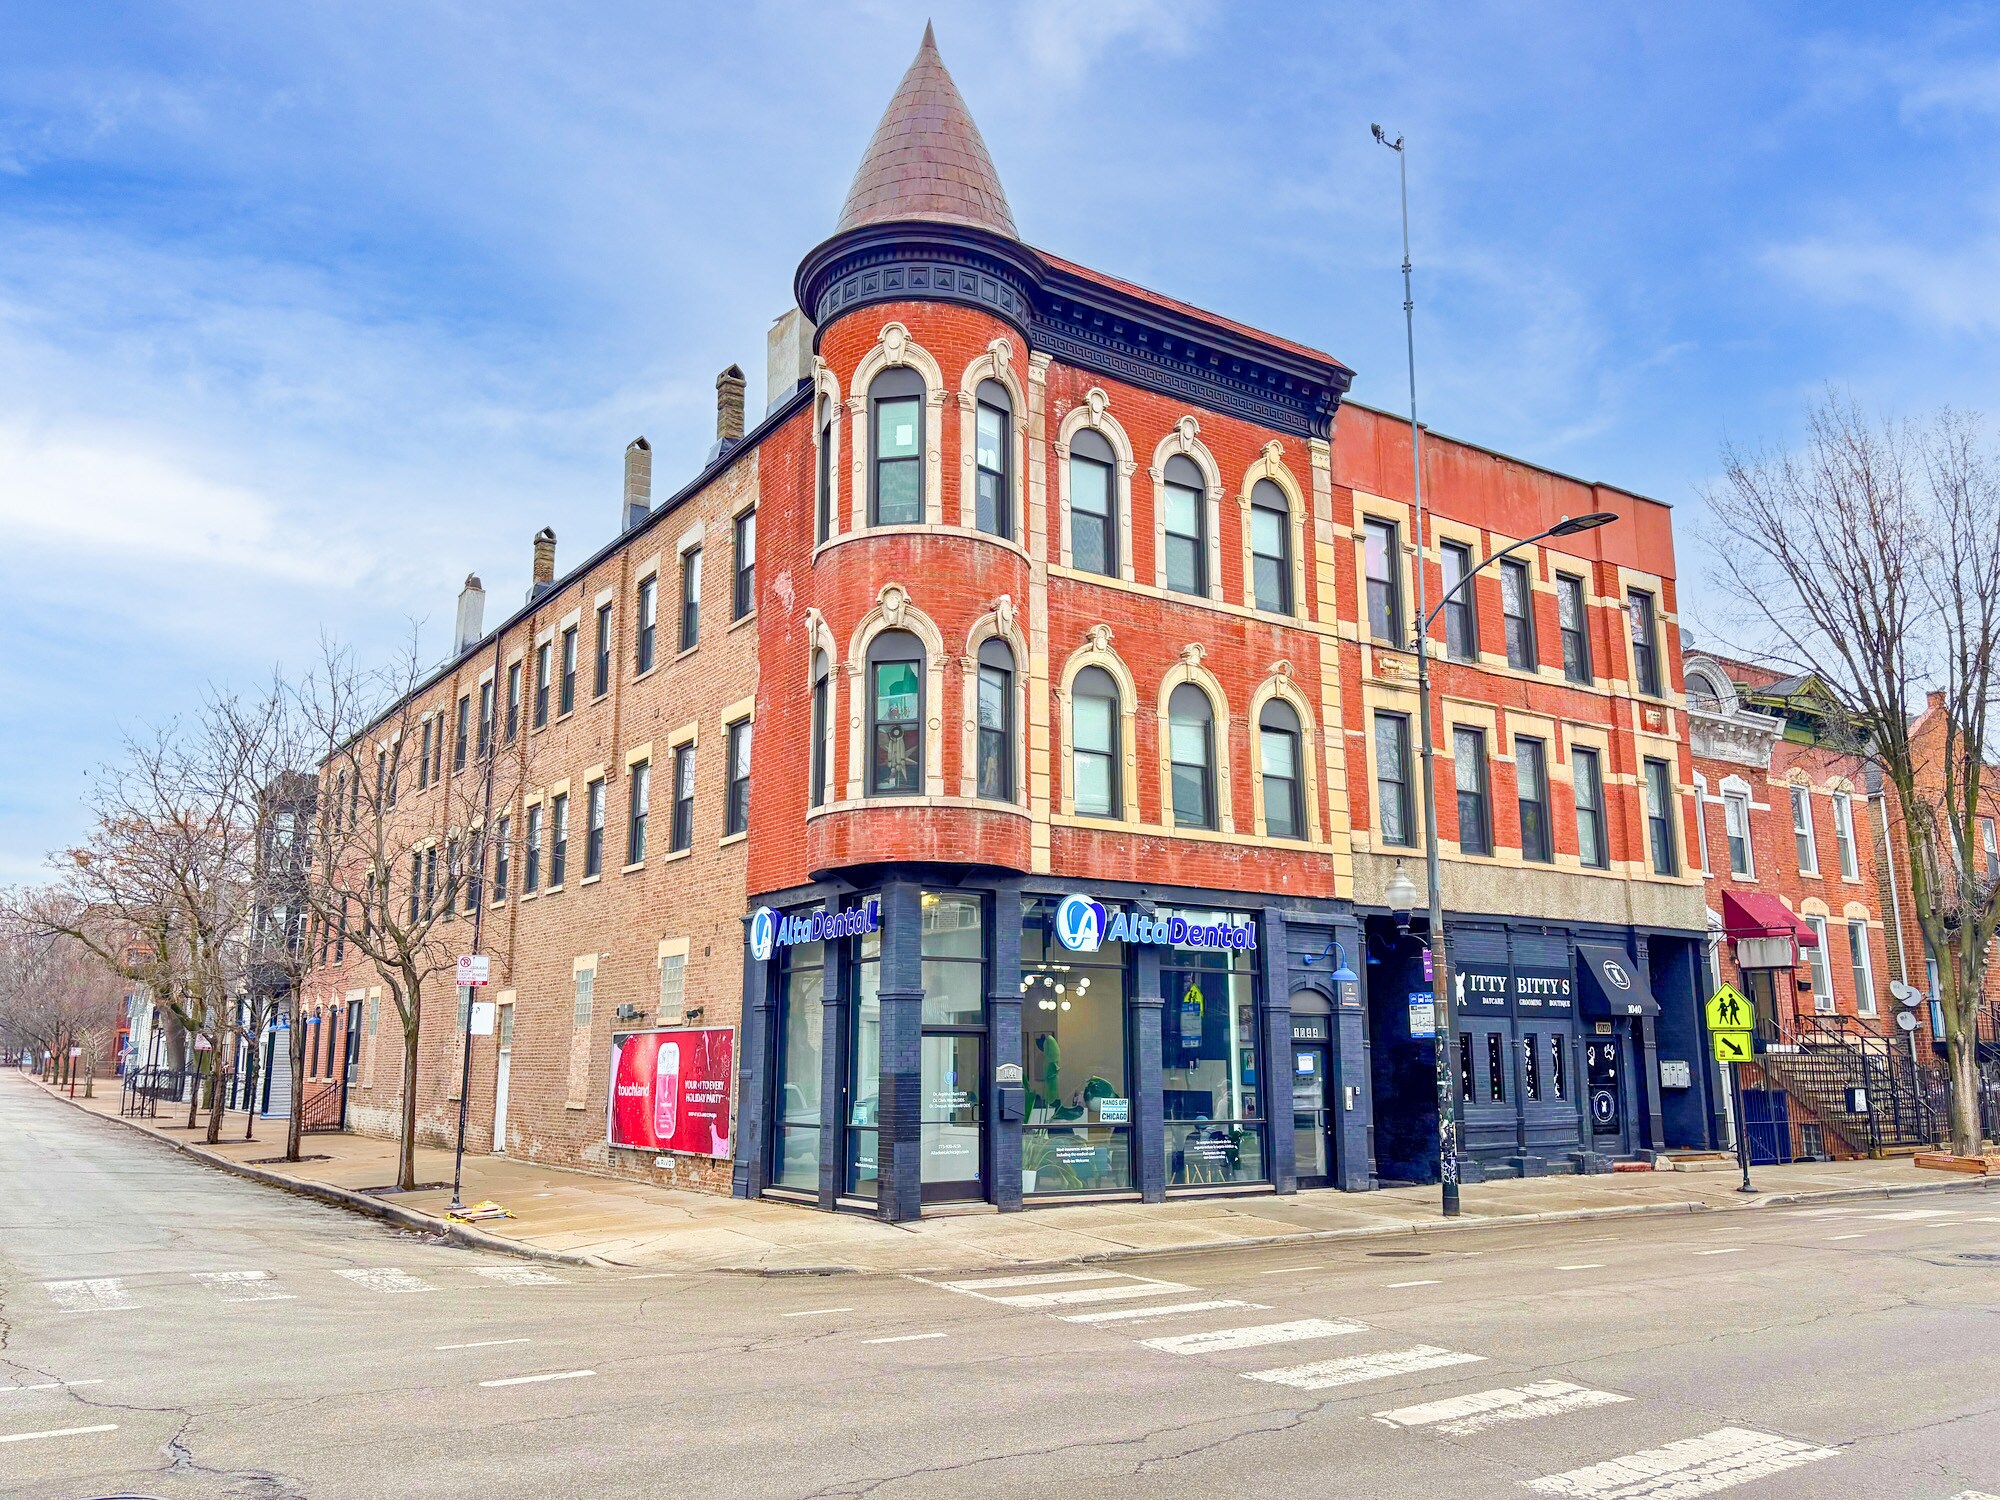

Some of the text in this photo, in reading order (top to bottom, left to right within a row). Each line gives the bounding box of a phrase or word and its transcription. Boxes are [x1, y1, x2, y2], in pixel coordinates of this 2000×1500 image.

[776, 900, 872, 947] AltaDental
[1108, 912, 1257, 949] AltaDental
[1470, 974, 1570, 995] ITTY BITTY'S
[1482, 997, 1571, 1008] DAYCARE GROOMING BOUTIQUE
[1627, 1004, 1643, 1014] 1040
[618, 1082, 650, 1097] touchland
[685, 1080, 698, 1090] YOUR
[710, 1080, 725, 1091] EVERY
[685, 1092, 706, 1102] HOLIDAY
[1101, 1112, 1127, 1121] CHICAGO
